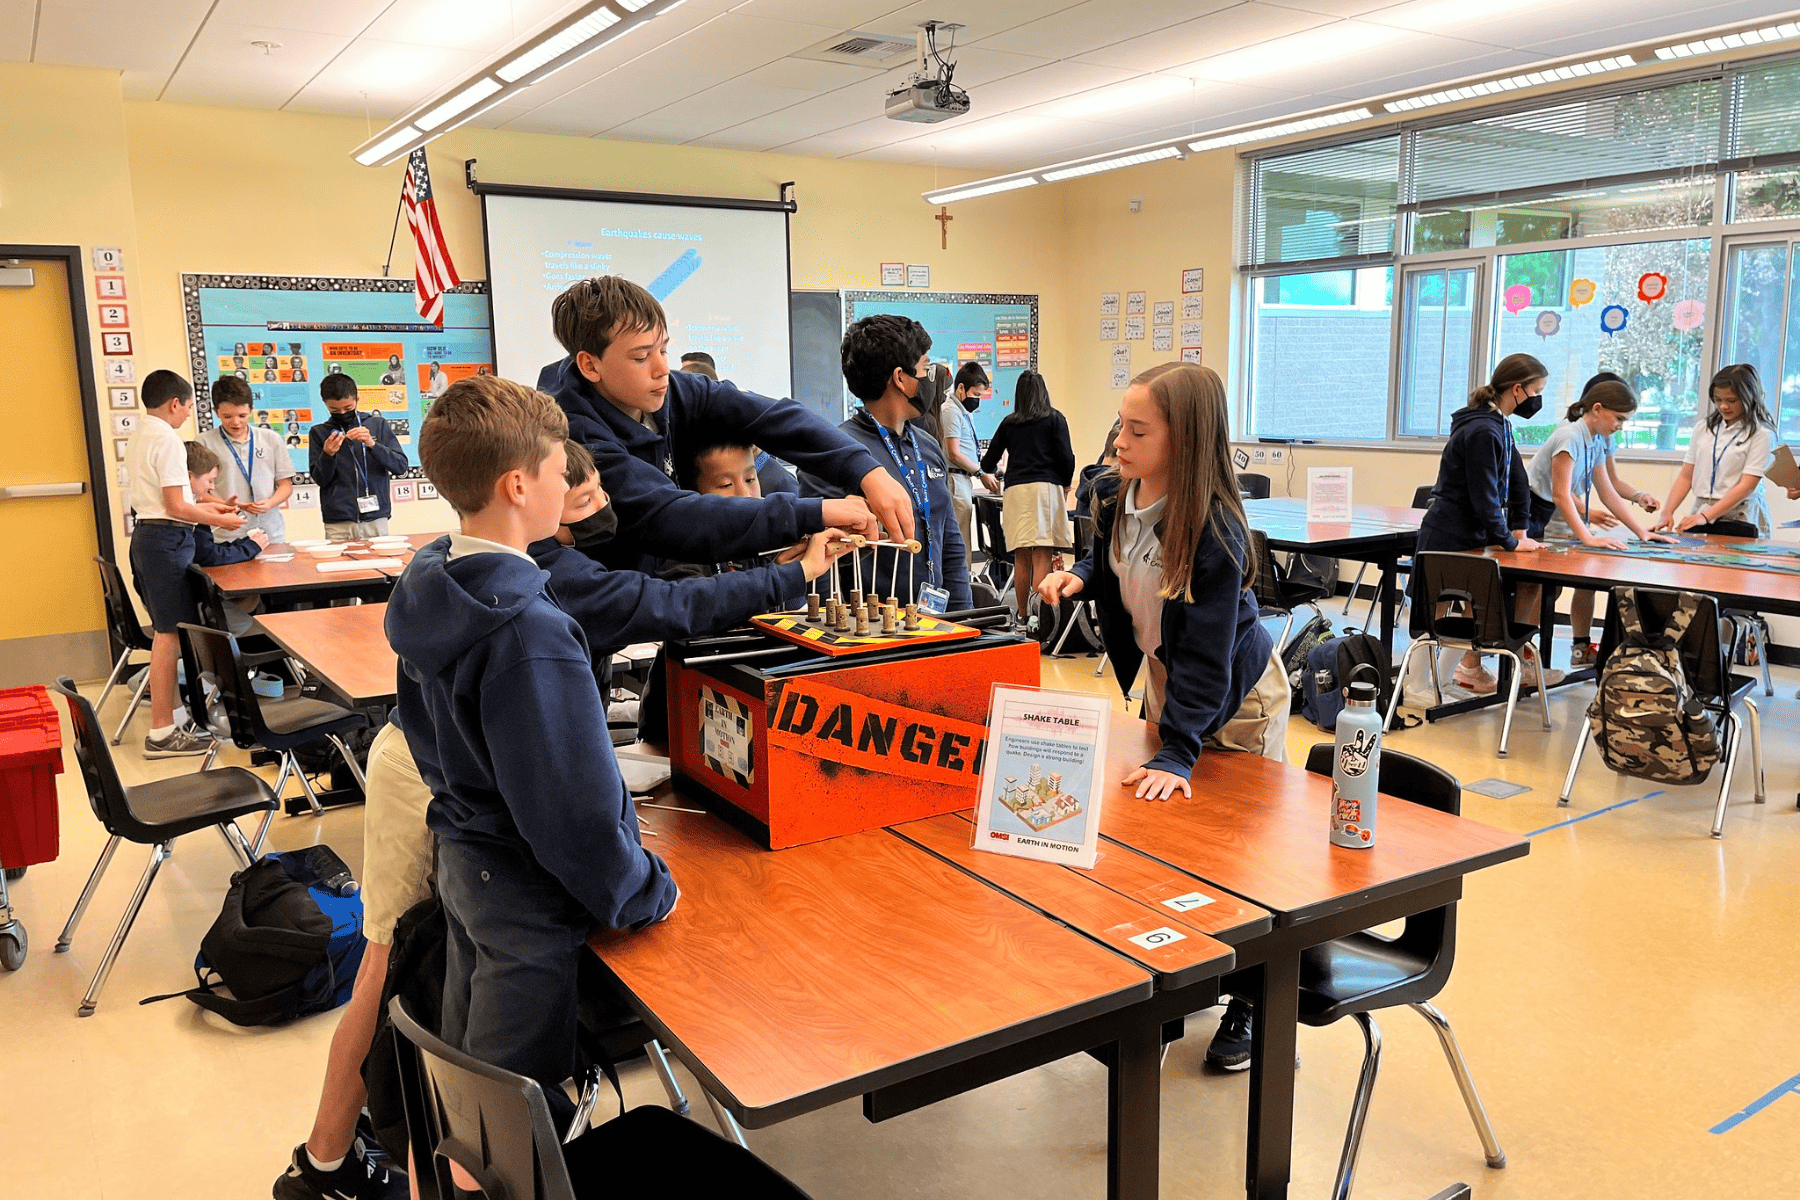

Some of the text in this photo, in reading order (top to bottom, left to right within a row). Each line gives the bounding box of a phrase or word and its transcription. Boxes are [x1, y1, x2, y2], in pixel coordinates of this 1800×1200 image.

[601, 228, 703, 241] Earthquakes cause waves
[104, 252, 113, 261] 0
[544, 251, 590, 260] Compression
[570, 262, 583, 270] like
[590, 264, 610, 272] slinky
[108, 281, 114, 290] 1
[109, 309, 118, 318] 2
[113, 337, 121, 347] 3
[115, 365, 124, 374] 4
[120, 392, 128, 401] 5
[122, 418, 130, 427] 6
[1237, 454, 1246, 463] 40
[397, 486, 410, 495] 18
[422, 485, 434, 494] 19
[296, 492, 310, 501] 14
[1023, 713, 1080, 727] SHAKE TABLE
[1005, 736, 1030, 744] Engineers
[1020, 744, 1042, 752] buildings
[1023, 751, 1041, 759] Design
[1046, 754, 1062, 762] strong
[990, 832, 1010, 841] OMSI
[1017, 838, 1040, 847] EARTH
[1049, 843, 1079, 853] MOTION
[1174, 899, 1200, 908] 7
